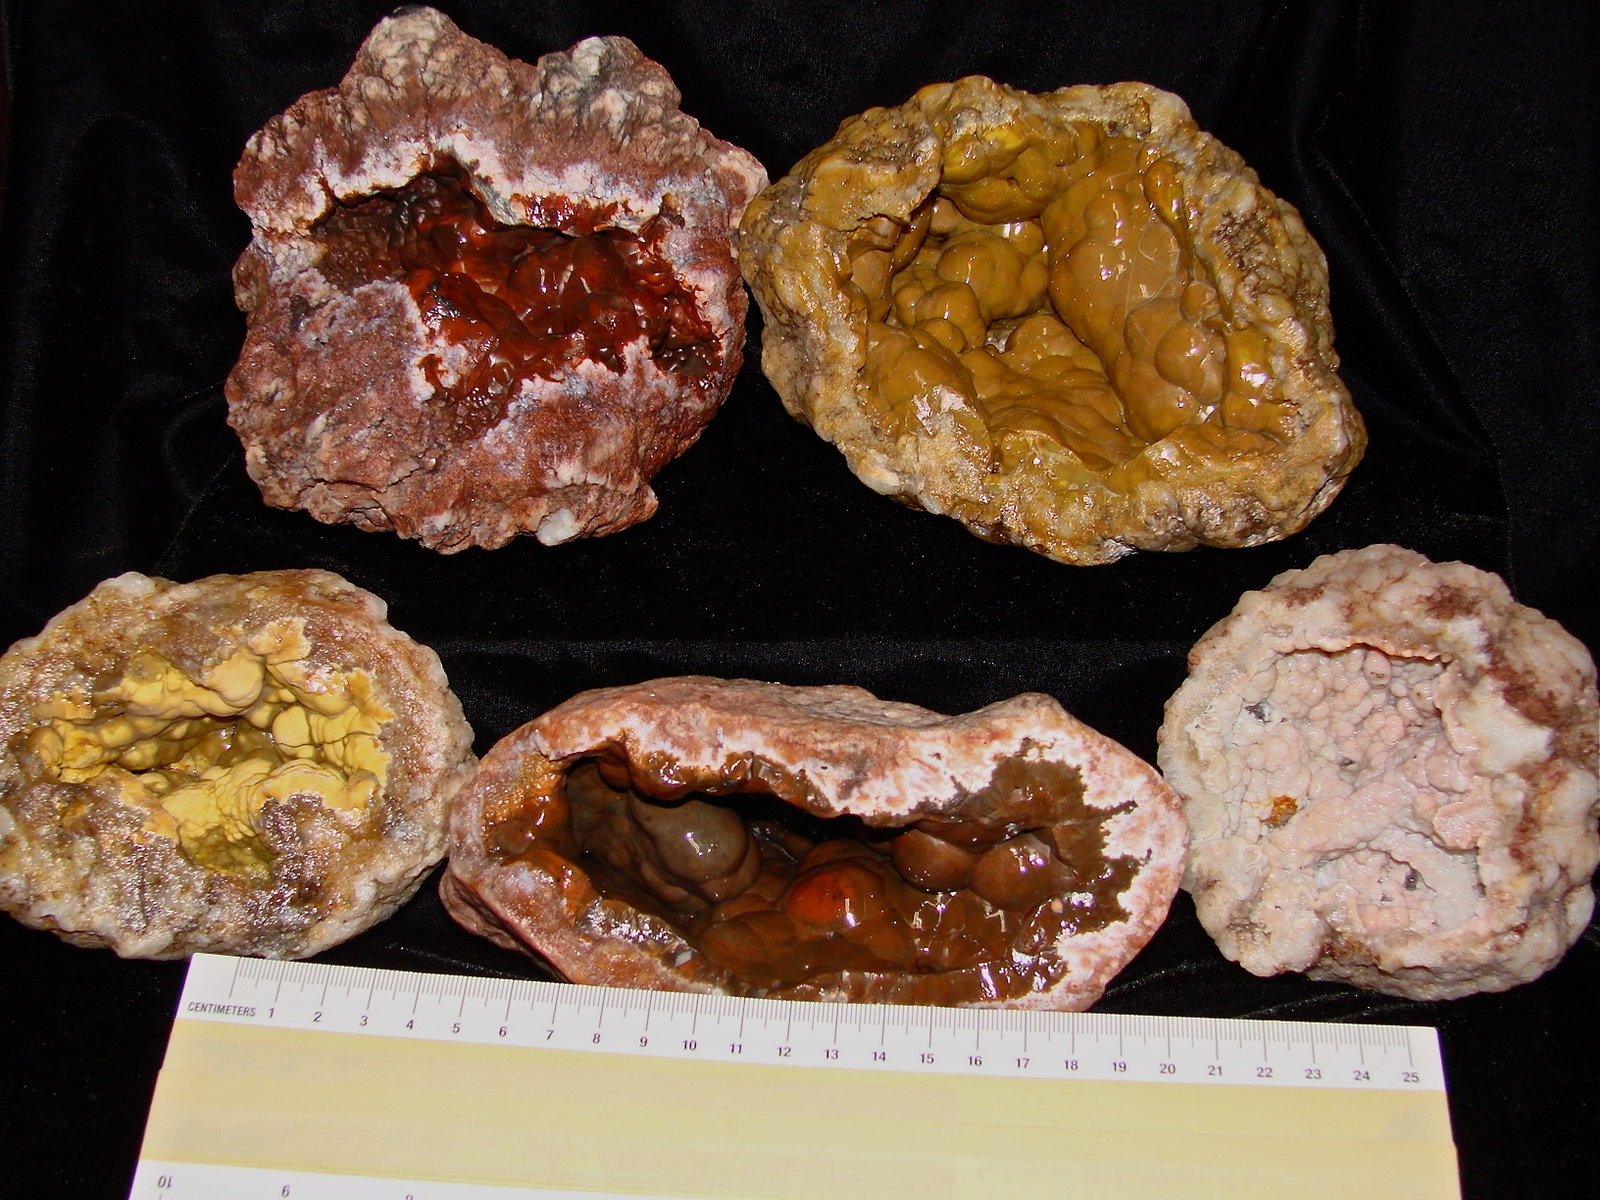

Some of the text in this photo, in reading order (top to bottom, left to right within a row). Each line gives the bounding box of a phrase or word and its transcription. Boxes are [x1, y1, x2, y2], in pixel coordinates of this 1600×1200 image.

[188, 1001, 256, 1017] CENTIMETERS
[313, 1011, 322, 1023] 2
[359, 1016, 369, 1027] 3
[406, 1019, 414, 1031] 4
[452, 1022, 461, 1034] 5
[498, 1026, 507, 1037] 6
[546, 1029, 555, 1041] 7
[592, 1032, 601, 1044] 8
[639, 1036, 648, 1048] 9
[682, 1039, 697, 1051] 10
[730, 1043, 742, 1054] 11
[776, 1046, 792, 1057] 12
[825, 1049, 839, 1060] 13
[872, 1051, 886, 1062] 14
[920, 1053, 935, 1064] 15
[968, 1055, 983, 1067] 16
[1016, 1058, 1030, 1069] 17
[1064, 1060, 1079, 1071] 18
[1111, 1061, 1127, 1072] 19
[1160, 1063, 1176, 1075] 20
[1208, 1065, 1222, 1076] 21
[1257, 1066, 1273, 1078] 22
[1305, 1068, 1322, 1080] 23
[1354, 1070, 1370, 1081] 24
[1403, 1071, 1420, 1083] 25
